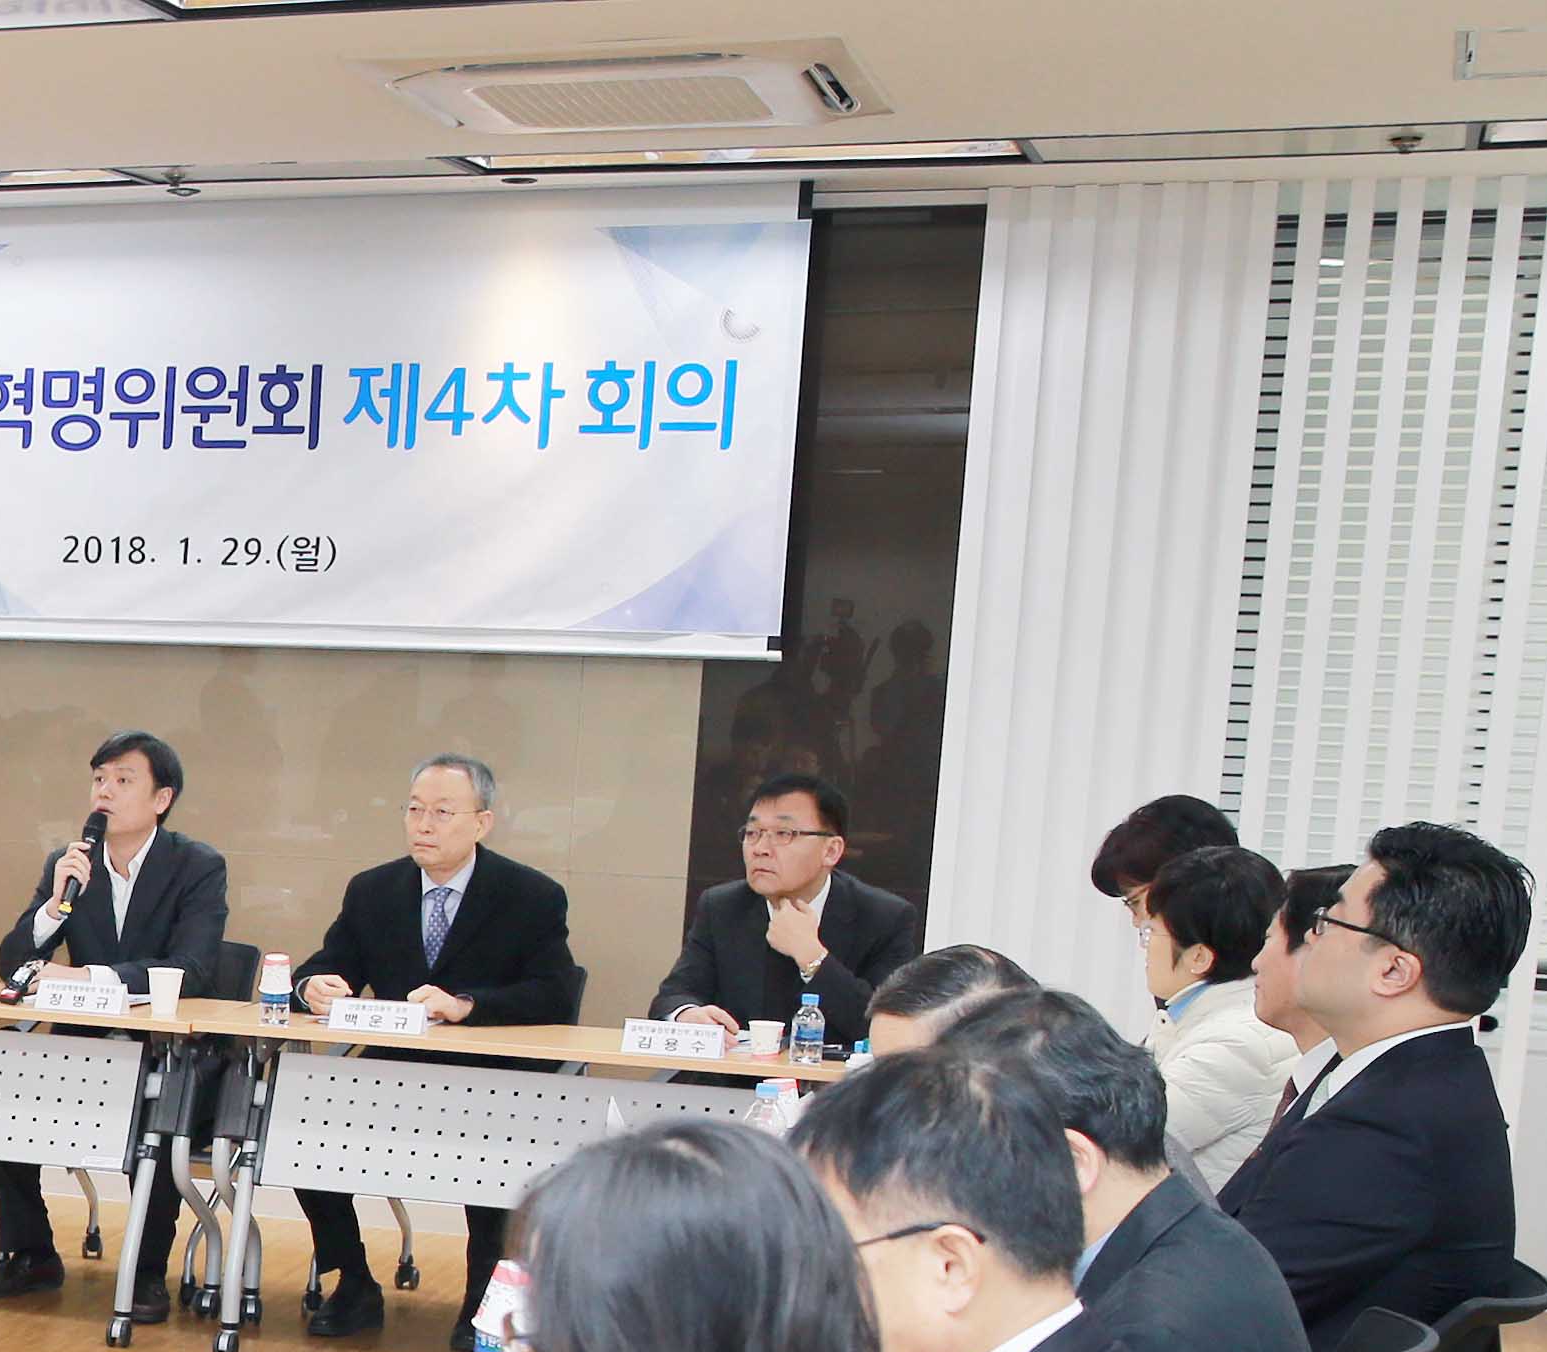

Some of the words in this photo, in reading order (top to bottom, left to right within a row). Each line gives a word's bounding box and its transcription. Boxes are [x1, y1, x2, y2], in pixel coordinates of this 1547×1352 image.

[342, 360, 564, 450] 제4차
[576, 357, 740, 452] 회의
[61, 534, 158, 567] 2018.
[177, 536, 203, 567] 1.
[219, 533, 339, 575] 29.(월)
